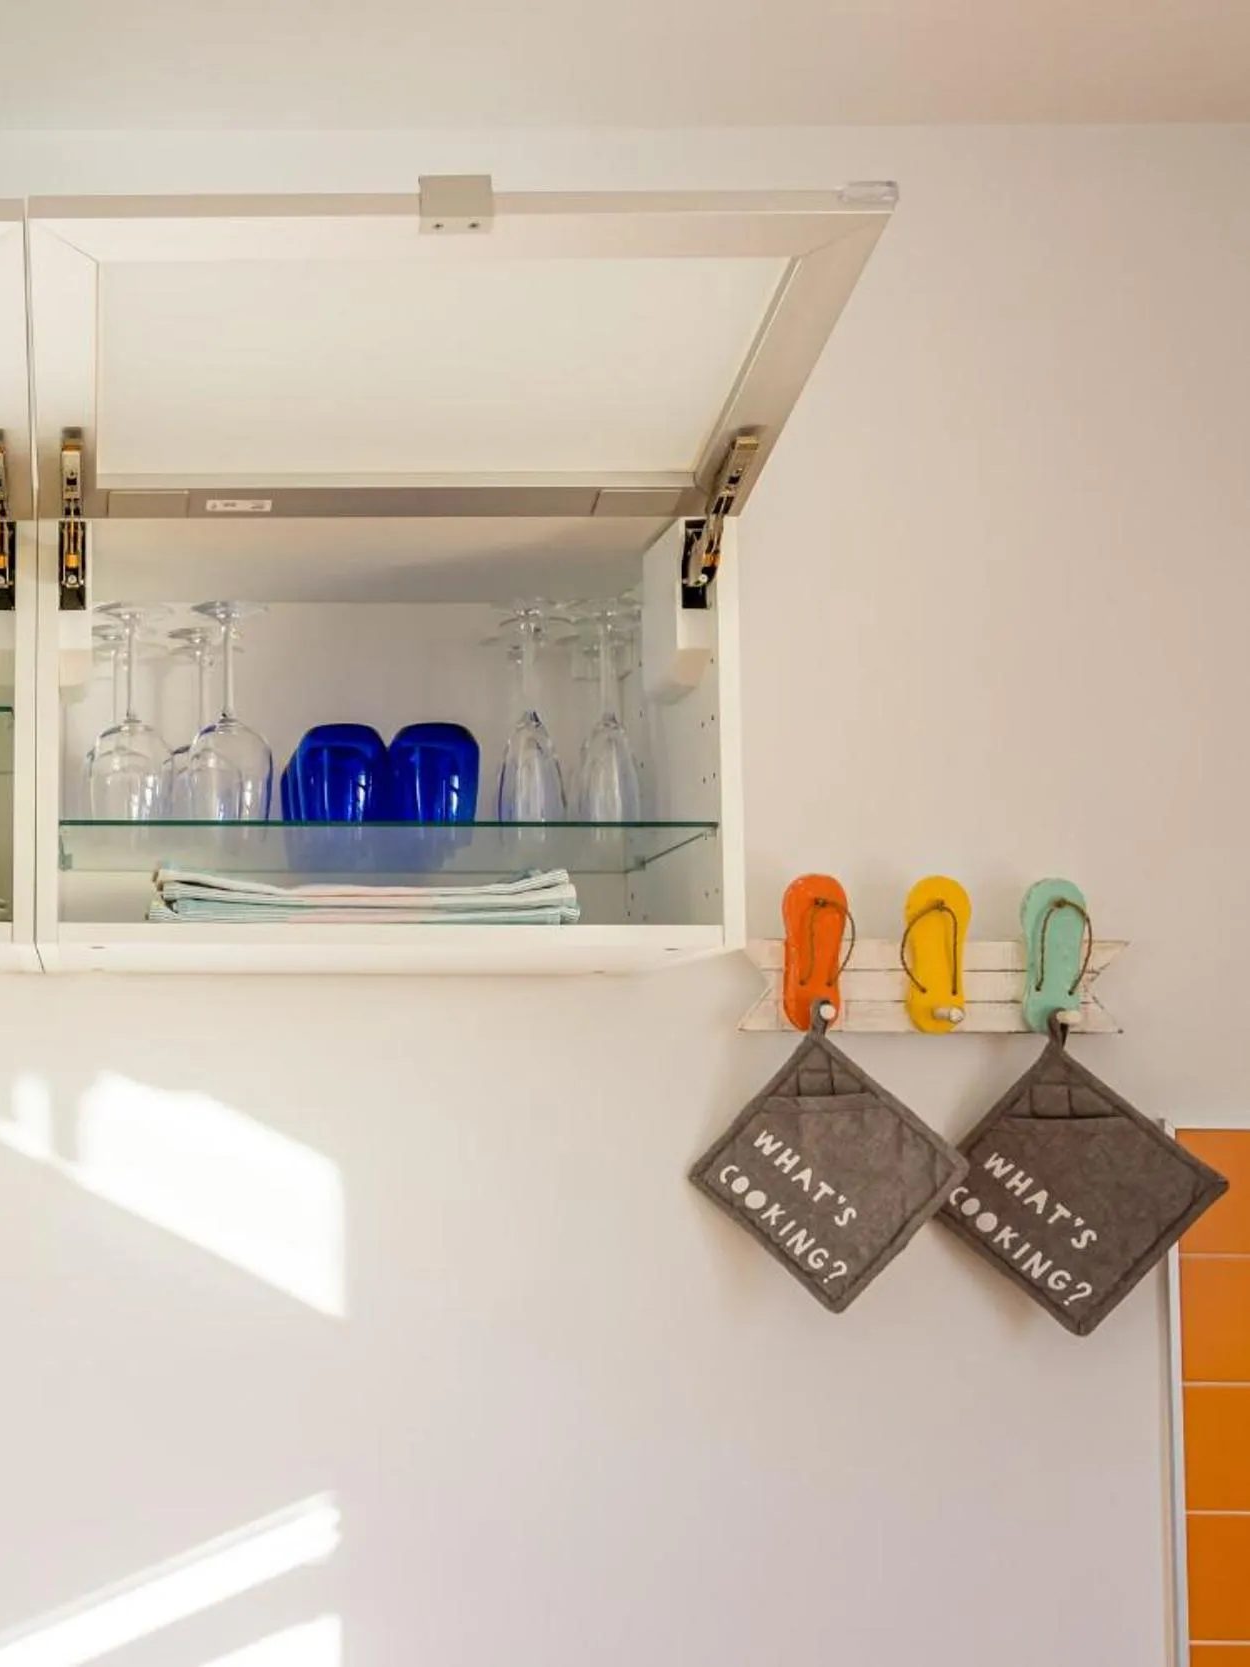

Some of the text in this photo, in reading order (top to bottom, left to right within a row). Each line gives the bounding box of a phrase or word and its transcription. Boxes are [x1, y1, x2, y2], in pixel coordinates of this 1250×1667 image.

[719, 1165, 848, 1284] COOKING?
[753, 1130, 857, 1227] WHAT'S
[983, 1152, 1097, 1249] WHAT'S
[949, 1187, 1093, 1306] COOKING?
